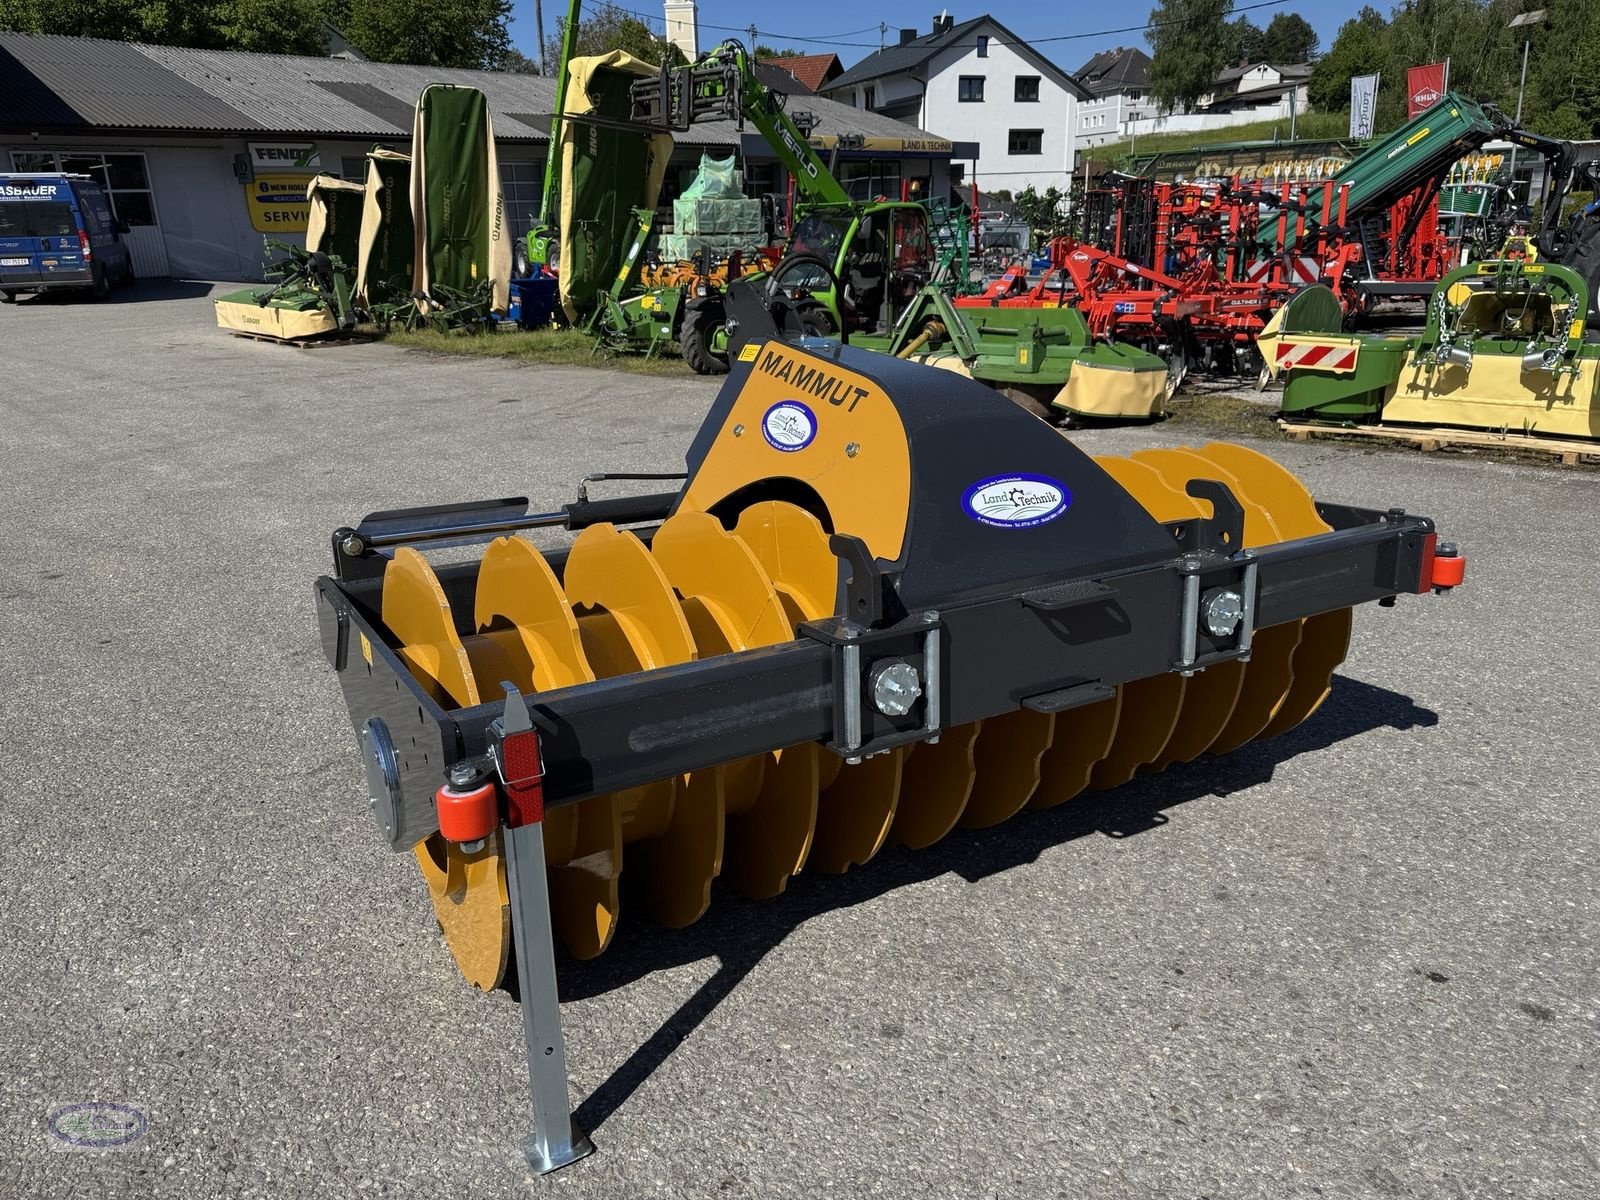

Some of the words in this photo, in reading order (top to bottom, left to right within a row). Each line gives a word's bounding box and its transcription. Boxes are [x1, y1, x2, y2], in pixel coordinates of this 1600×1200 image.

[1361, 92, 1371, 121] Land
[774, 119, 818, 178] MERLO
[903, 140, 921, 150] LAND
[921, 141, 927, 150] &
[928, 141, 952, 151] TECHNIK
[495, 192, 504, 228] KRONE
[759, 350, 870, 413] MAMMUT
[775, 410, 791, 424] Land
[786, 424, 806, 441] Technik
[982, 491, 1008, 504] Land
[1018, 492, 1057, 506] Technik
